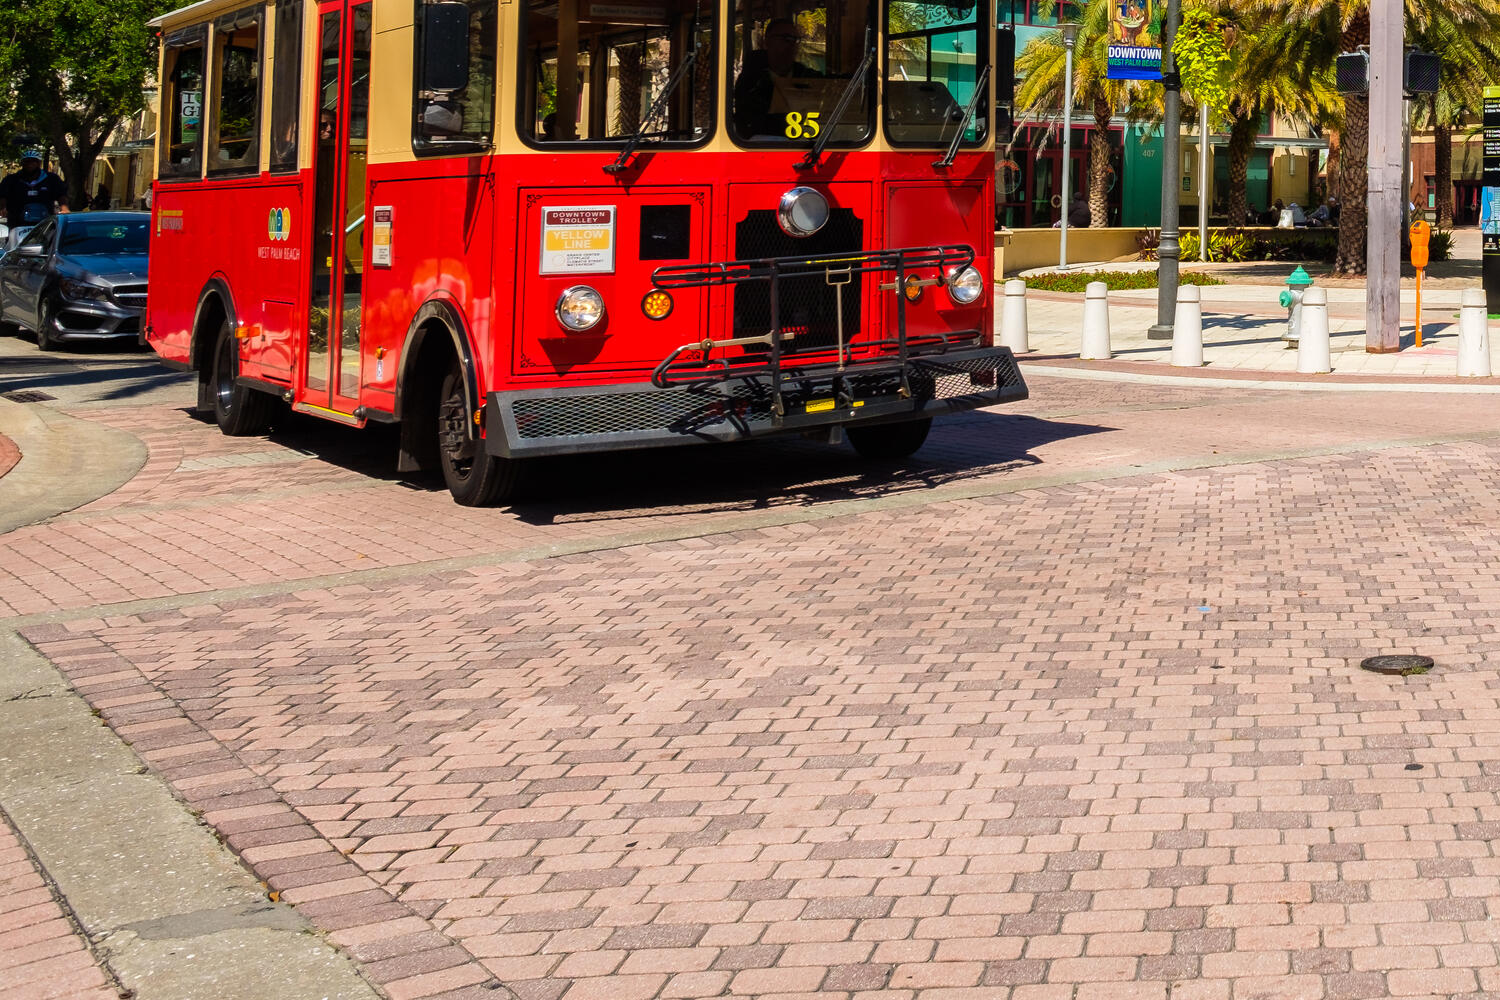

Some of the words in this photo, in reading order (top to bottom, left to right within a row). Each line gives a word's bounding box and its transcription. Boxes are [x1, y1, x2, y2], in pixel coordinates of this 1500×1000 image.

[1108, 47, 1162, 60] DOWNTOWN
[1108, 58, 1124, 66] WEST
[1125, 58, 1141, 67] PALM
[1141, 59, 1162, 68] BEACH
[785, 112, 820, 138] 85
[552, 230, 604, 240] YELLOW
[564, 240, 591, 249] LINE
[258, 247, 270, 258] WEST
[270, 247, 283, 259] PALM
[283, 248, 300, 260] BEACH
